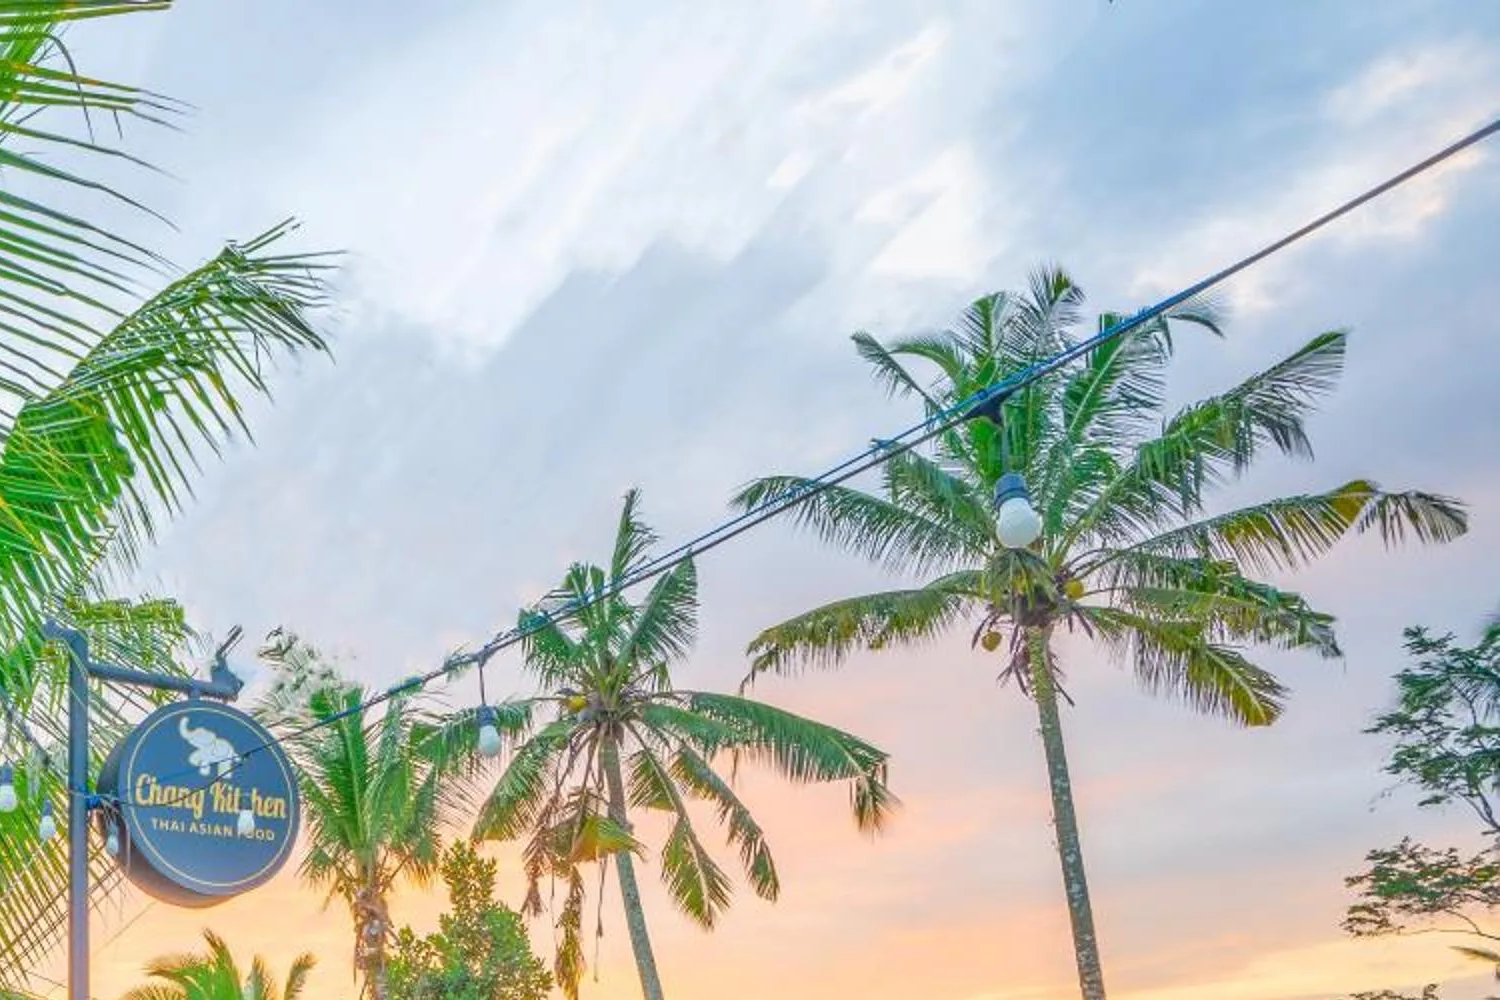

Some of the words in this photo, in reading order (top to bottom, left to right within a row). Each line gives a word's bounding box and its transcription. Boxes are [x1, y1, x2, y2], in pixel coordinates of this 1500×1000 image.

[135, 773, 206, 819] Chang
[210, 782, 286, 818] Kithen
[152, 817, 186, 832] THAI
[189, 821, 233, 837] ASIAN
